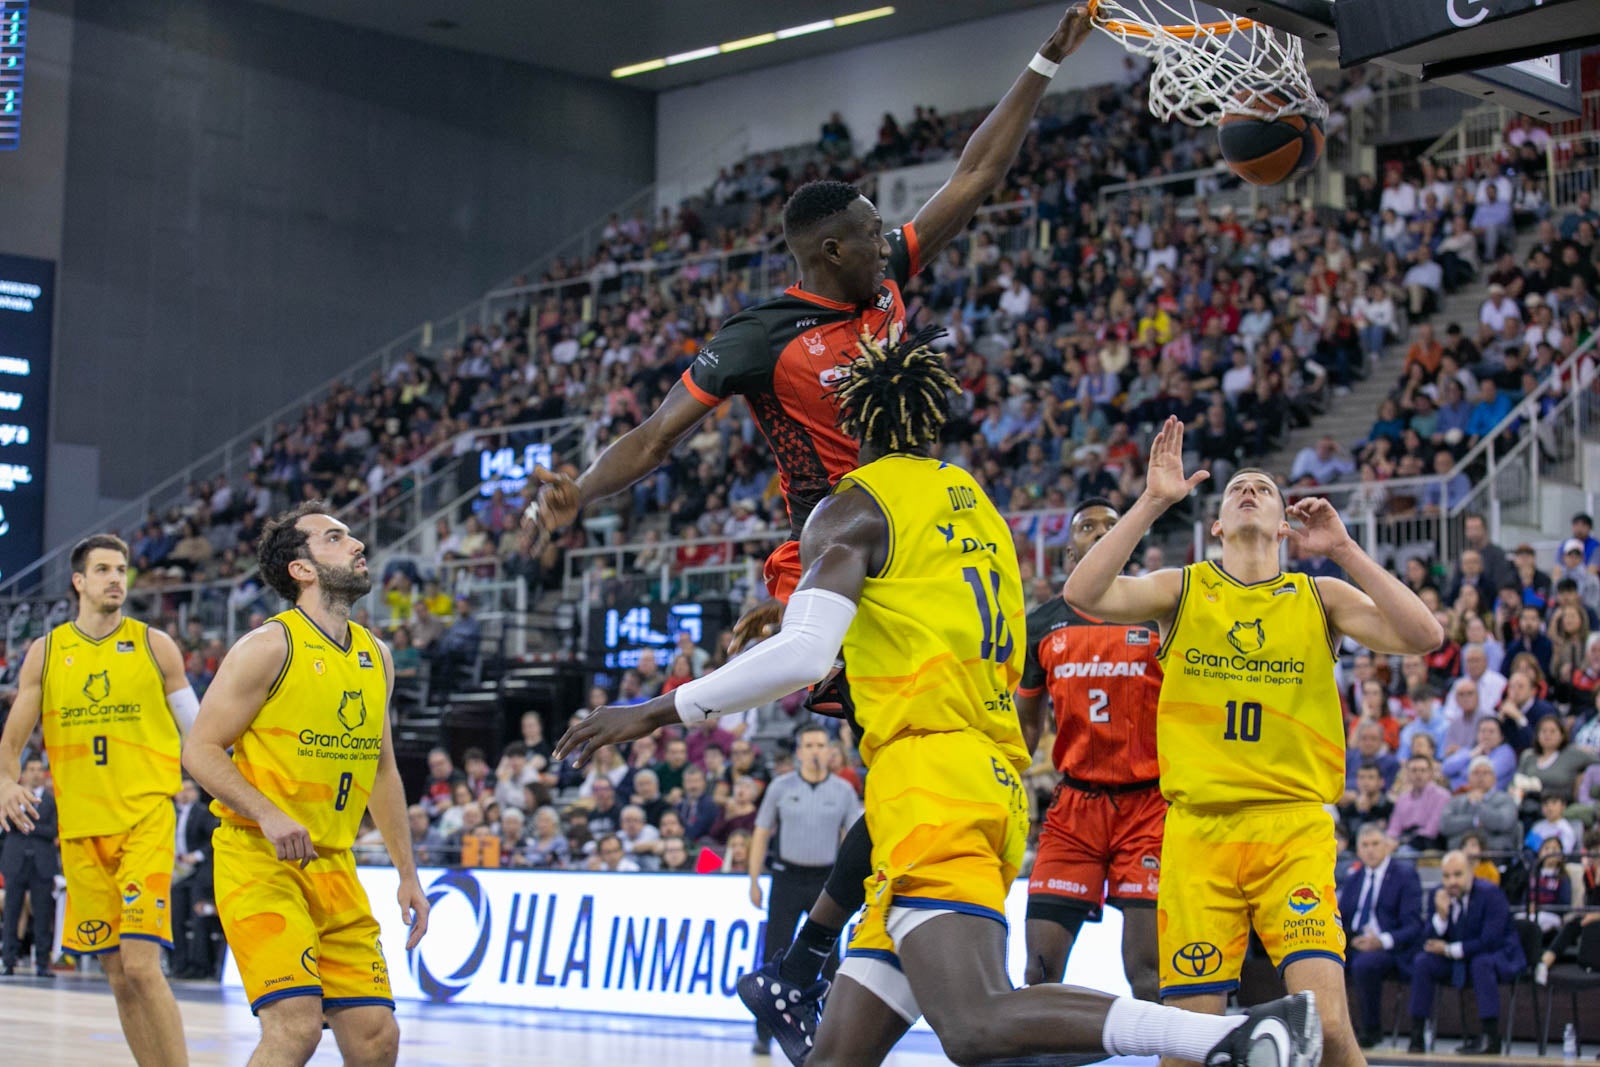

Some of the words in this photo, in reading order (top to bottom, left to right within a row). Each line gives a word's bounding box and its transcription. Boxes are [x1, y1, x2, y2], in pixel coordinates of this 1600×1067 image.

[1184, 667, 1201, 677] Isla
[1203, 668, 1243, 682] Europea
[1246, 674, 1262, 683] del
[1088, 688, 1110, 723] 2
[1224, 700, 1262, 742] 10
[93, 736, 108, 766] 9
[298, 747, 313, 757] Isla
[316, 749, 348, 760] Europea
[335, 772, 353, 811] 8
[1283, 918, 1326, 931] Poema
[1283, 930, 1298, 942] del
[1302, 926, 1325, 937] Mar
[500, 893, 594, 989] HLA
